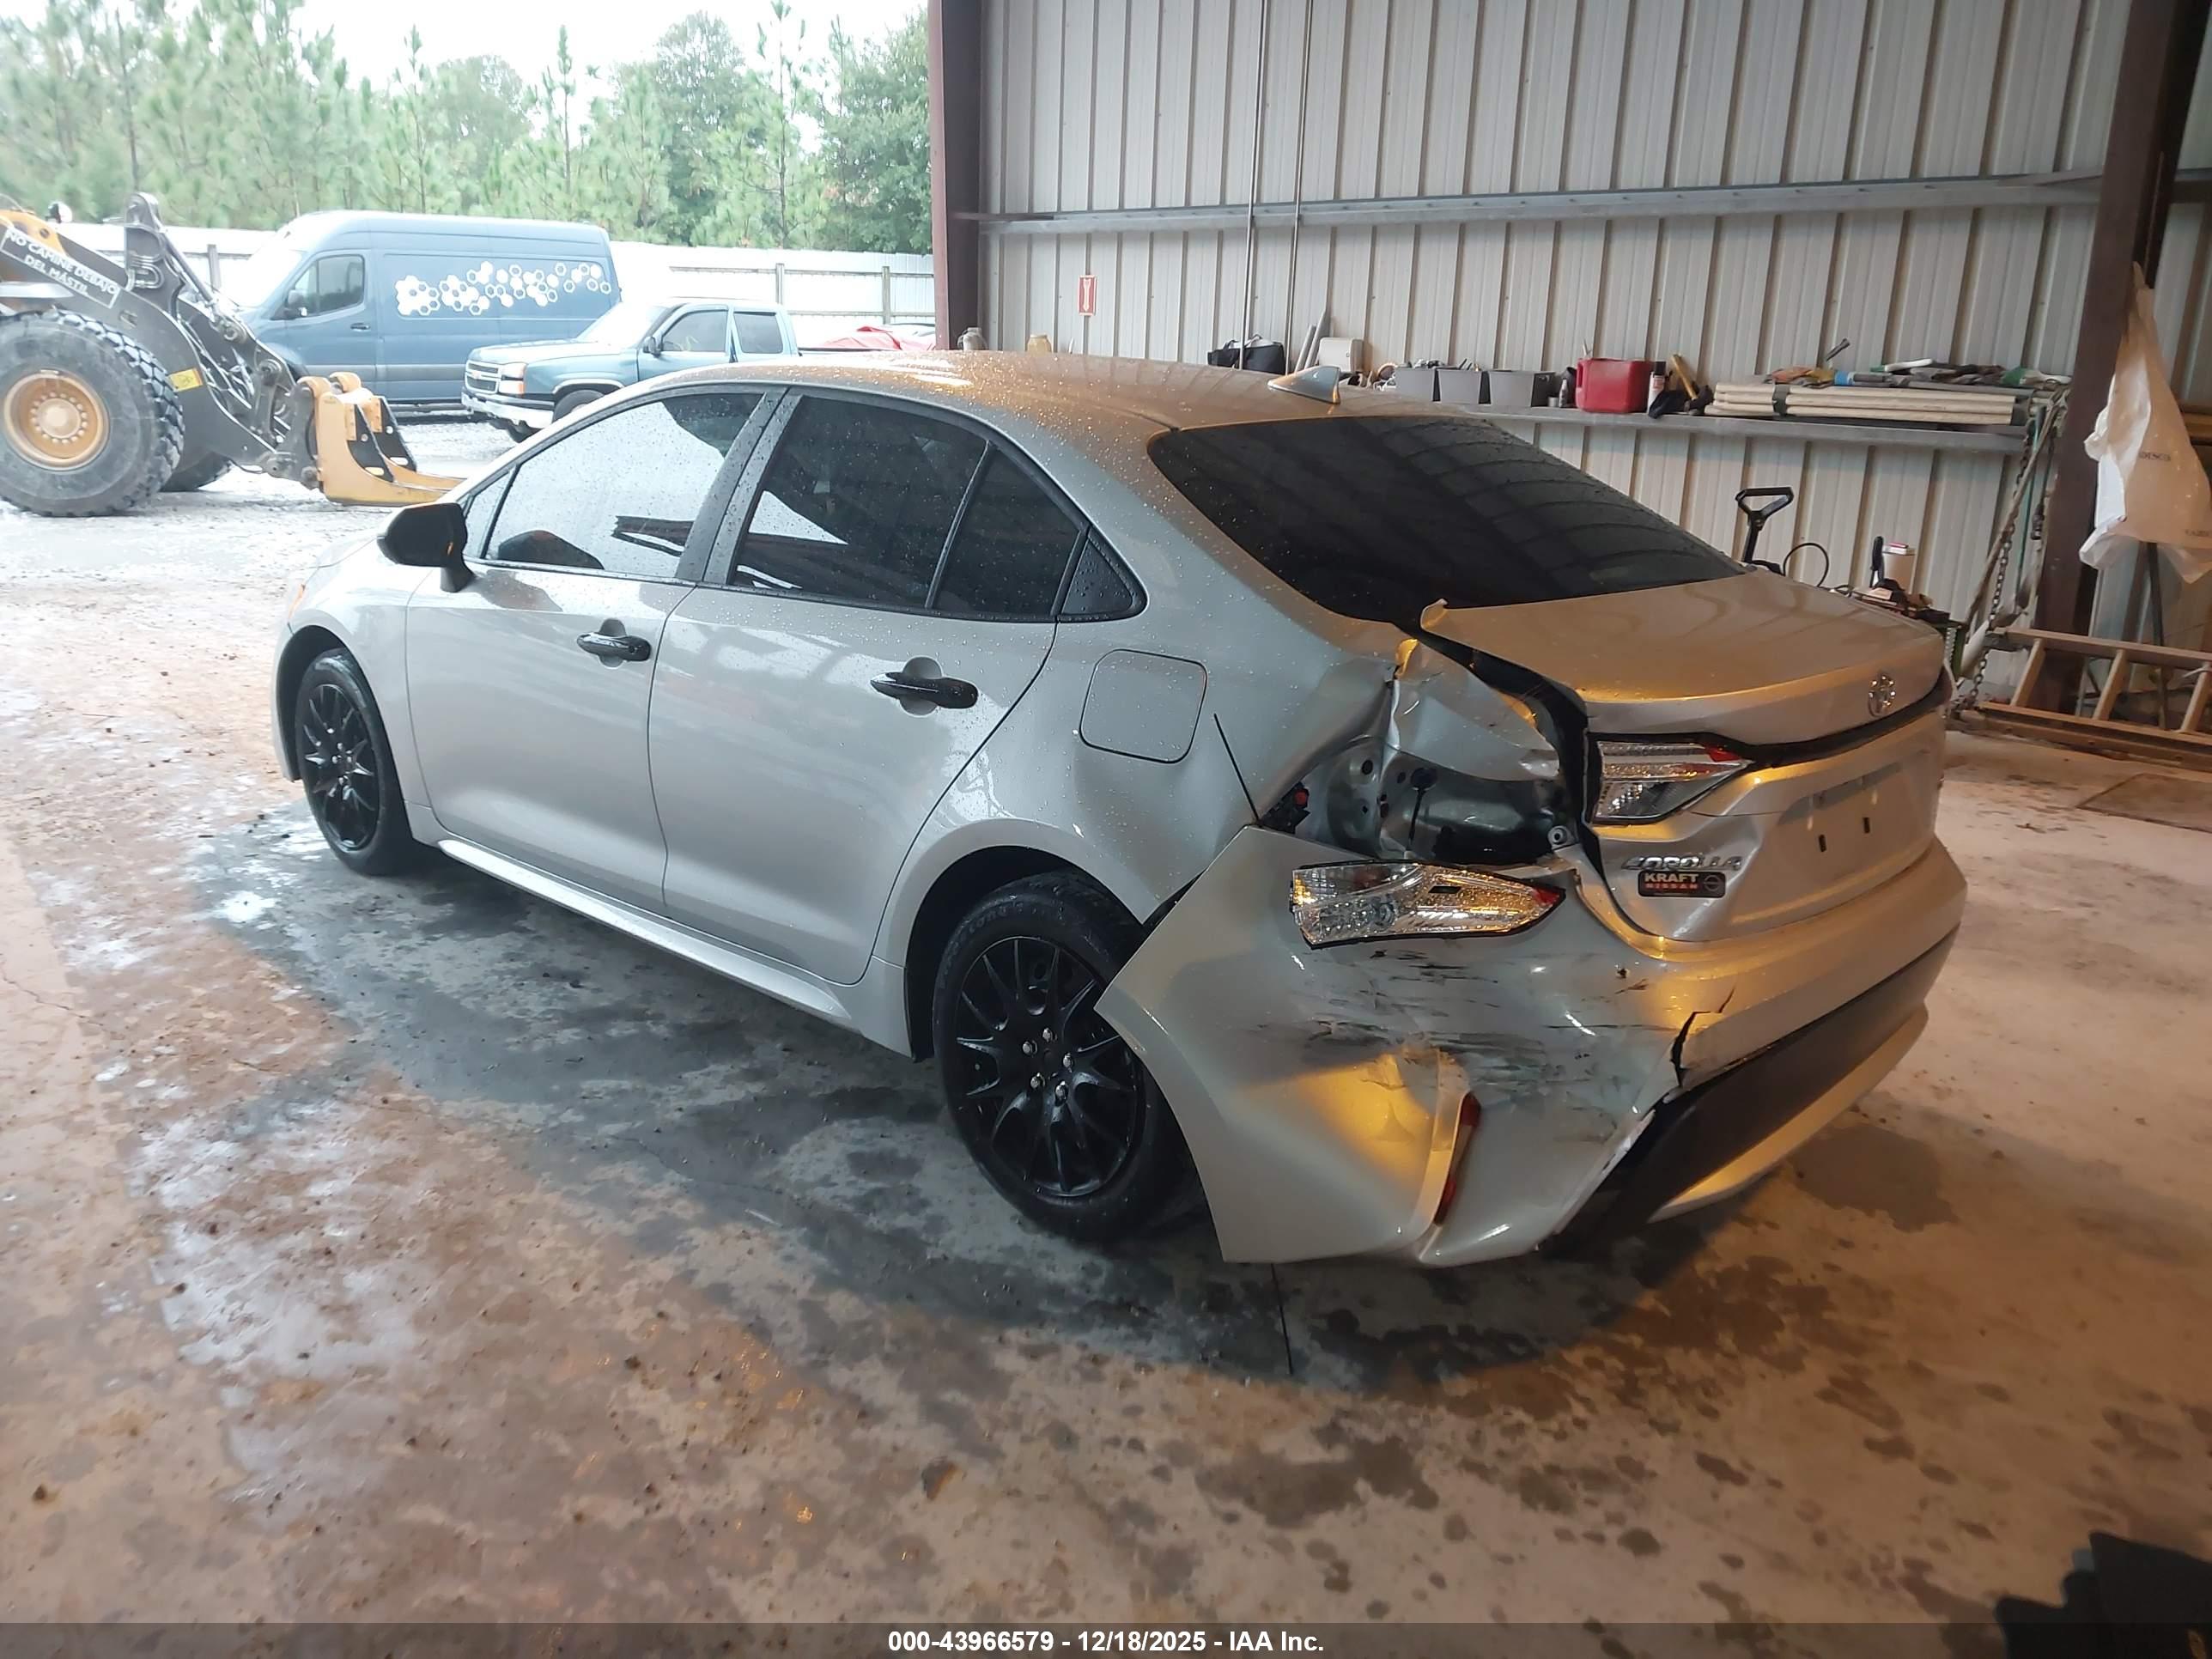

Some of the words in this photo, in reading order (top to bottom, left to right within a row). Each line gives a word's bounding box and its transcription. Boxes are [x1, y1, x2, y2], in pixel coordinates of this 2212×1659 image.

[8, 231, 27, 246] NO
[28, 243, 74, 271] CAMINE
[75, 264, 117, 294] DEBAJO
[24, 255, 46, 273] DEL
[1644, 873, 1698, 883] KRAFT
